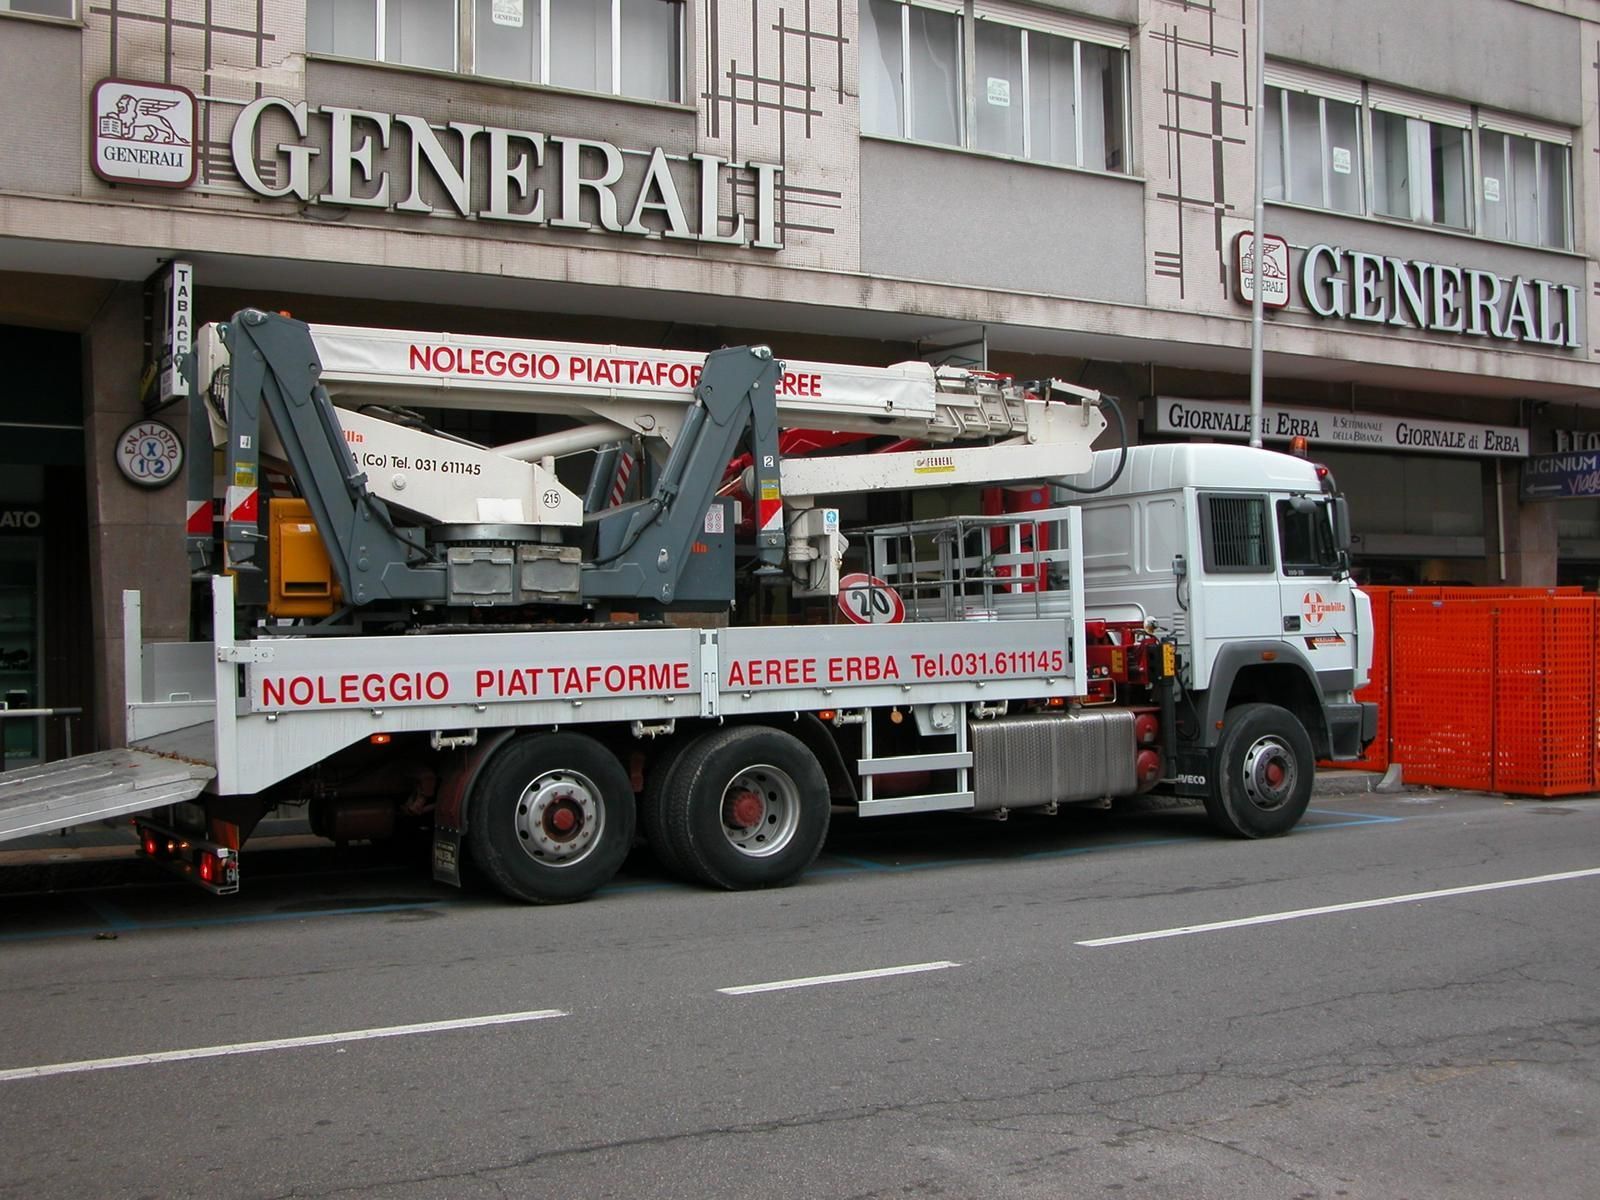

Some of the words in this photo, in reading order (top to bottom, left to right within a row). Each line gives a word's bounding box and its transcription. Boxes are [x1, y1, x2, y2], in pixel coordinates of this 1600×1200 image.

[103, 145, 185, 168] GENERALI
[231, 96, 784, 250] GENERALI
[1244, 277, 1284, 294] GEERALI
[1301, 243, 1581, 349] GENERALI
[177, 270, 189, 387] TABACCI
[409, 344, 560, 380] NOLEGGIO
[1276, 412, 1320, 438] ERBA
[1354, 431, 1383, 443] BRIANZA
[1396, 422, 1466, 449] GIORNALE
[1468, 433, 1478, 450] di
[1483, 429, 1520, 452] ERBA
[125, 426, 178, 460] ENALOTTO
[146, 442, 157, 457] X
[138, 459, 145, 472] 1
[154, 460, 165, 473] 2
[363, 453, 387, 468] (Co)
[391, 456, 411, 469] Tel.
[415, 458, 436, 472] 031
[441, 461, 481, 476] 611145
[765, 456, 773, 467] 2
[543, 494, 560, 505] 215
[0, 511, 41, 528] ATO
[851, 588, 890, 616] 20
[728, 658, 817, 687] AEREE
[828, 655, 899, 683] ERBA
[911, 651, 1063, 678] Tel.031.611145
[262, 671, 449, 706] NOLEGGIO
[476, 663, 690, 697] PIATTAFORME
